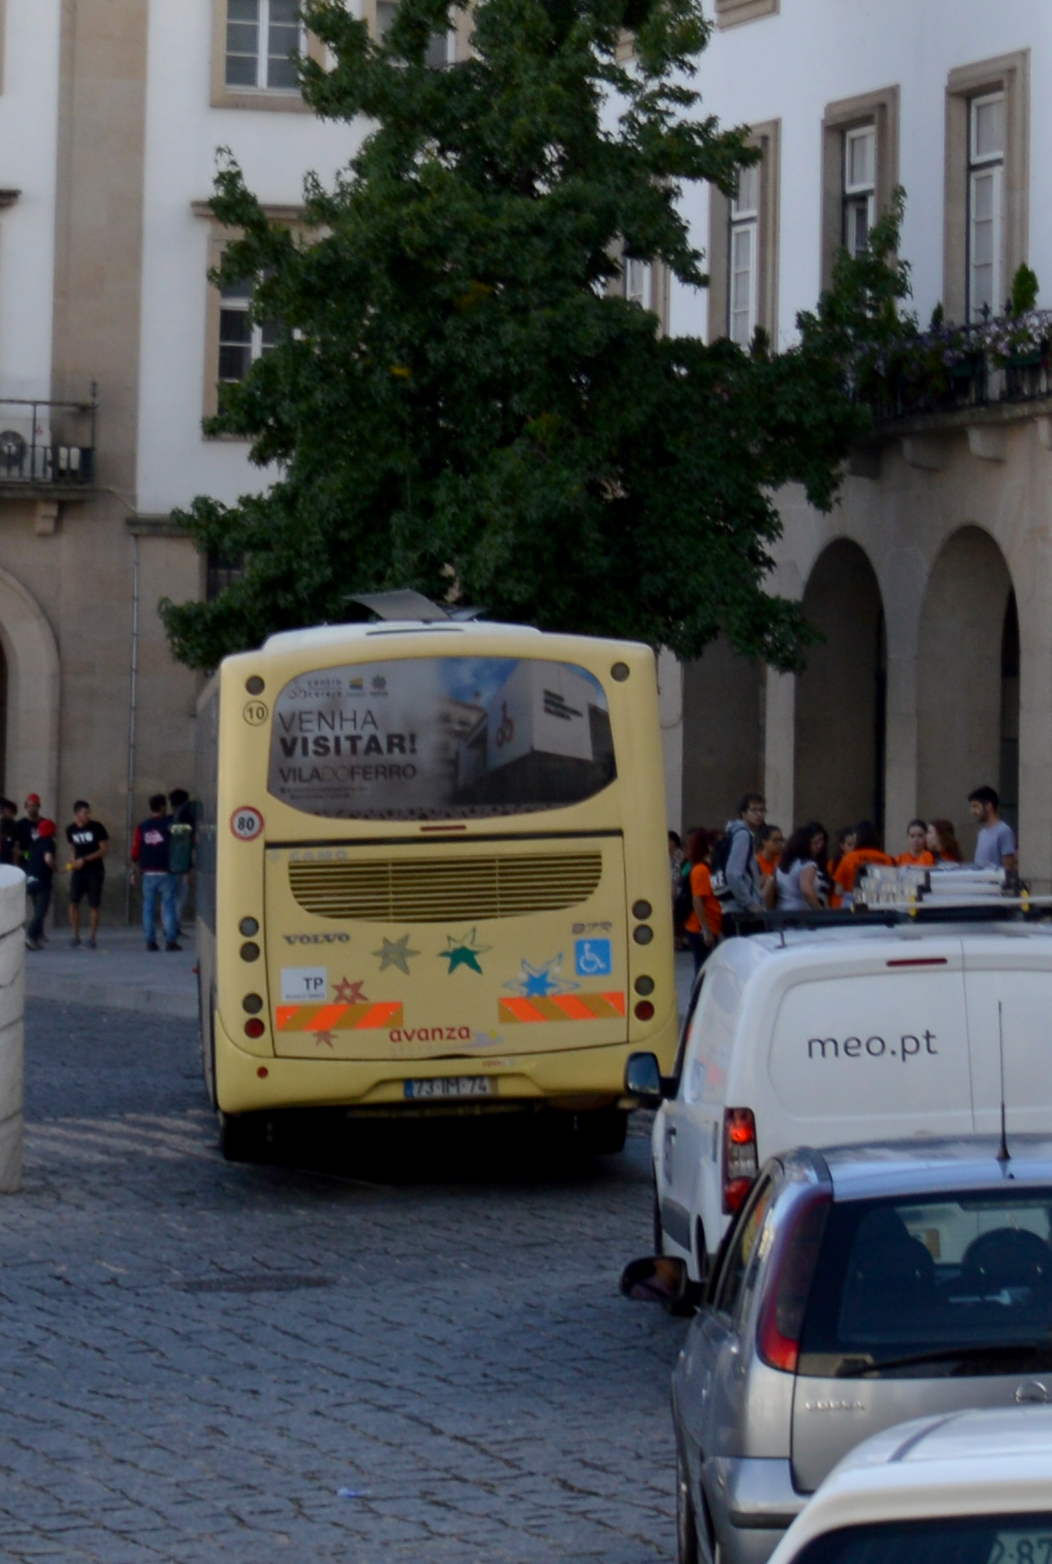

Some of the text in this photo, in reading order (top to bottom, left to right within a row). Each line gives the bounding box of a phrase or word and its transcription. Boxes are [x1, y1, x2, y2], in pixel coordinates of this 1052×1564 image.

[247, 707, 265, 720] 10
[278, 709, 379, 733] VENHA
[279, 733, 418, 757] VISITAR!
[237, 816, 255, 831] 80
[283, 933, 351, 945] VOLVO
[303, 977, 324, 990] TP
[389, 1026, 471, 1043] avanza
[807, 1029, 938, 1062] meo.pt
